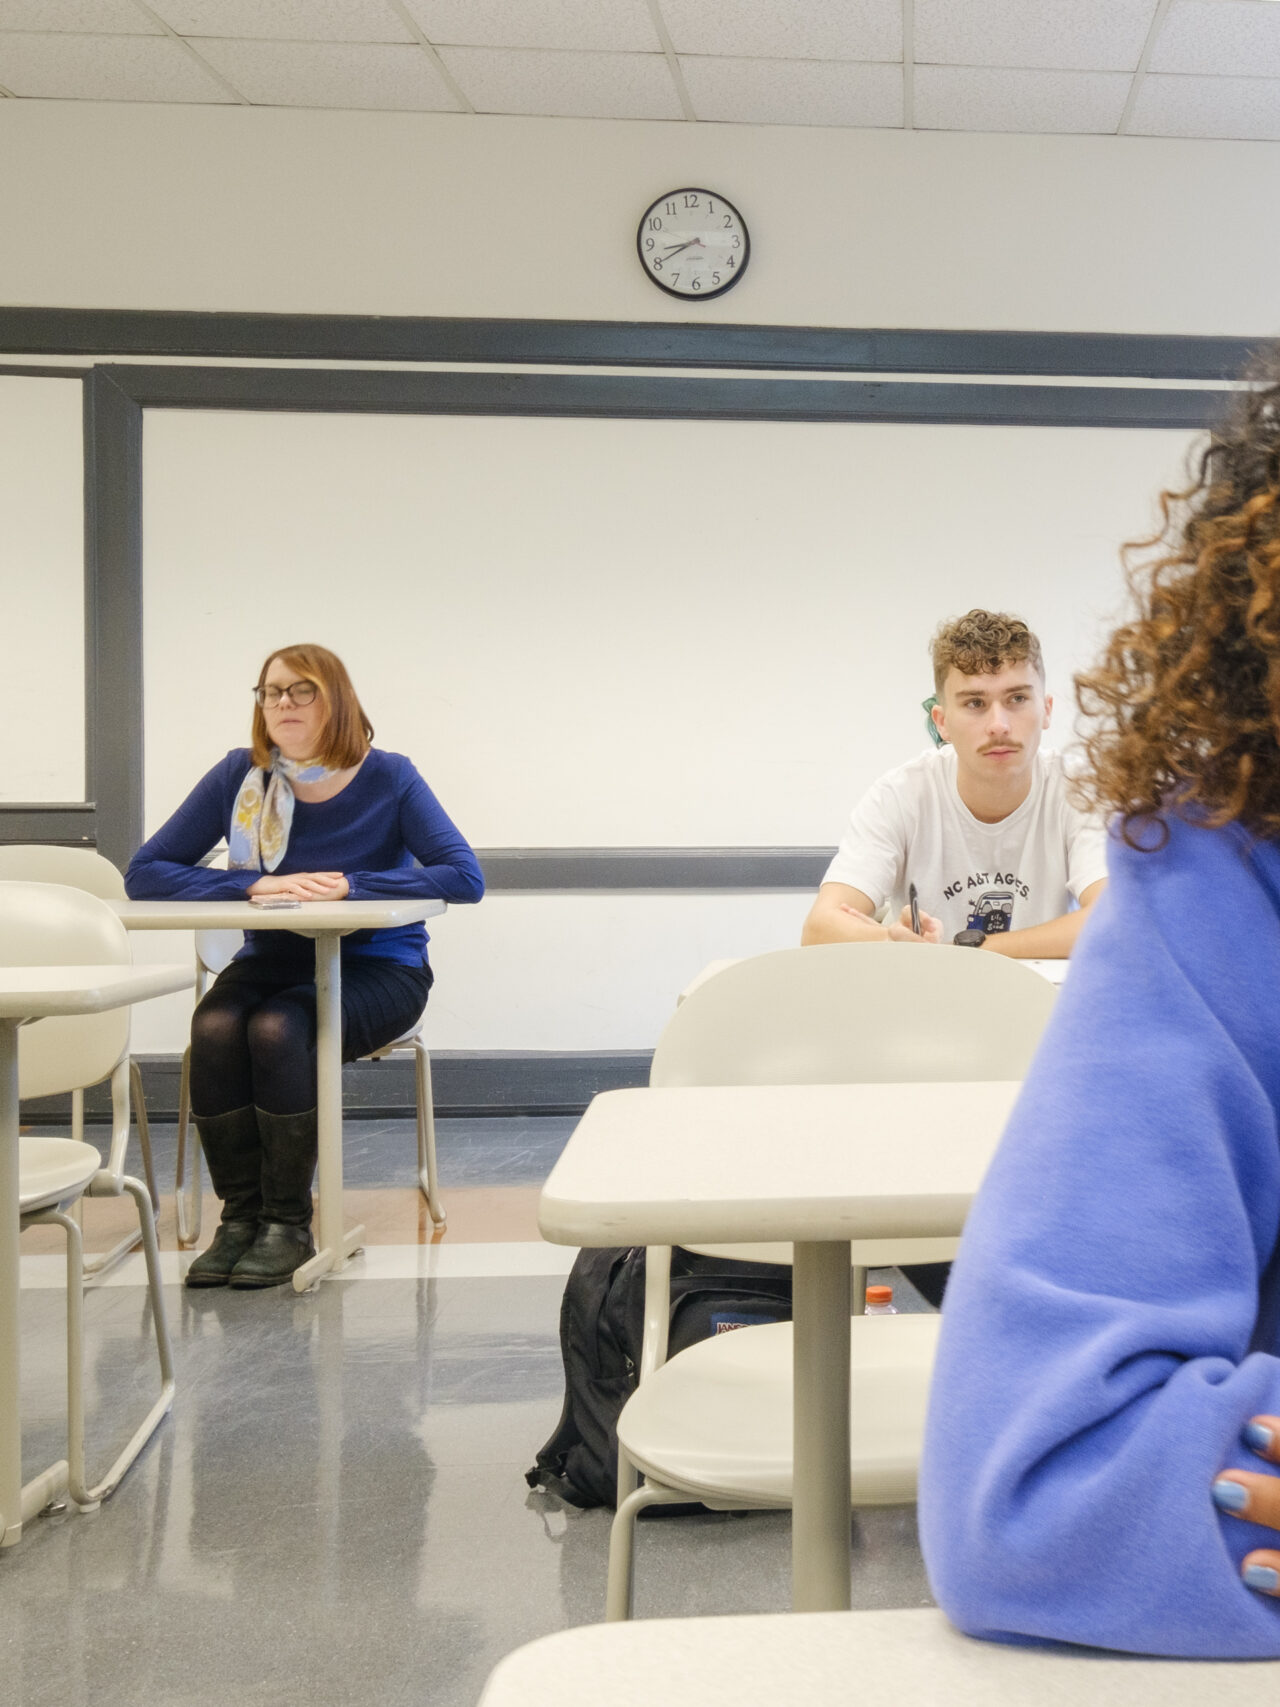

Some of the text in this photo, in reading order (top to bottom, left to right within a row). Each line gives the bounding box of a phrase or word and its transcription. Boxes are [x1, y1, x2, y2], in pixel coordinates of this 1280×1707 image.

[683, 194, 700, 208] 12
[709, 201, 715, 214] 1
[665, 202, 677, 215] 11
[648, 216, 662, 231] 10
[723, 215, 733, 228] 2
[645, 238, 655, 251] 9
[731, 235, 740, 248] 3
[653, 257, 663, 271] 8
[726, 255, 735, 268] 4
[671, 273, 680, 286] 7
[692, 276, 701, 290] 6
[712, 271, 721, 285] 5
[943, 881, 963, 900] NC
[967, 872, 990, 888] A&T
